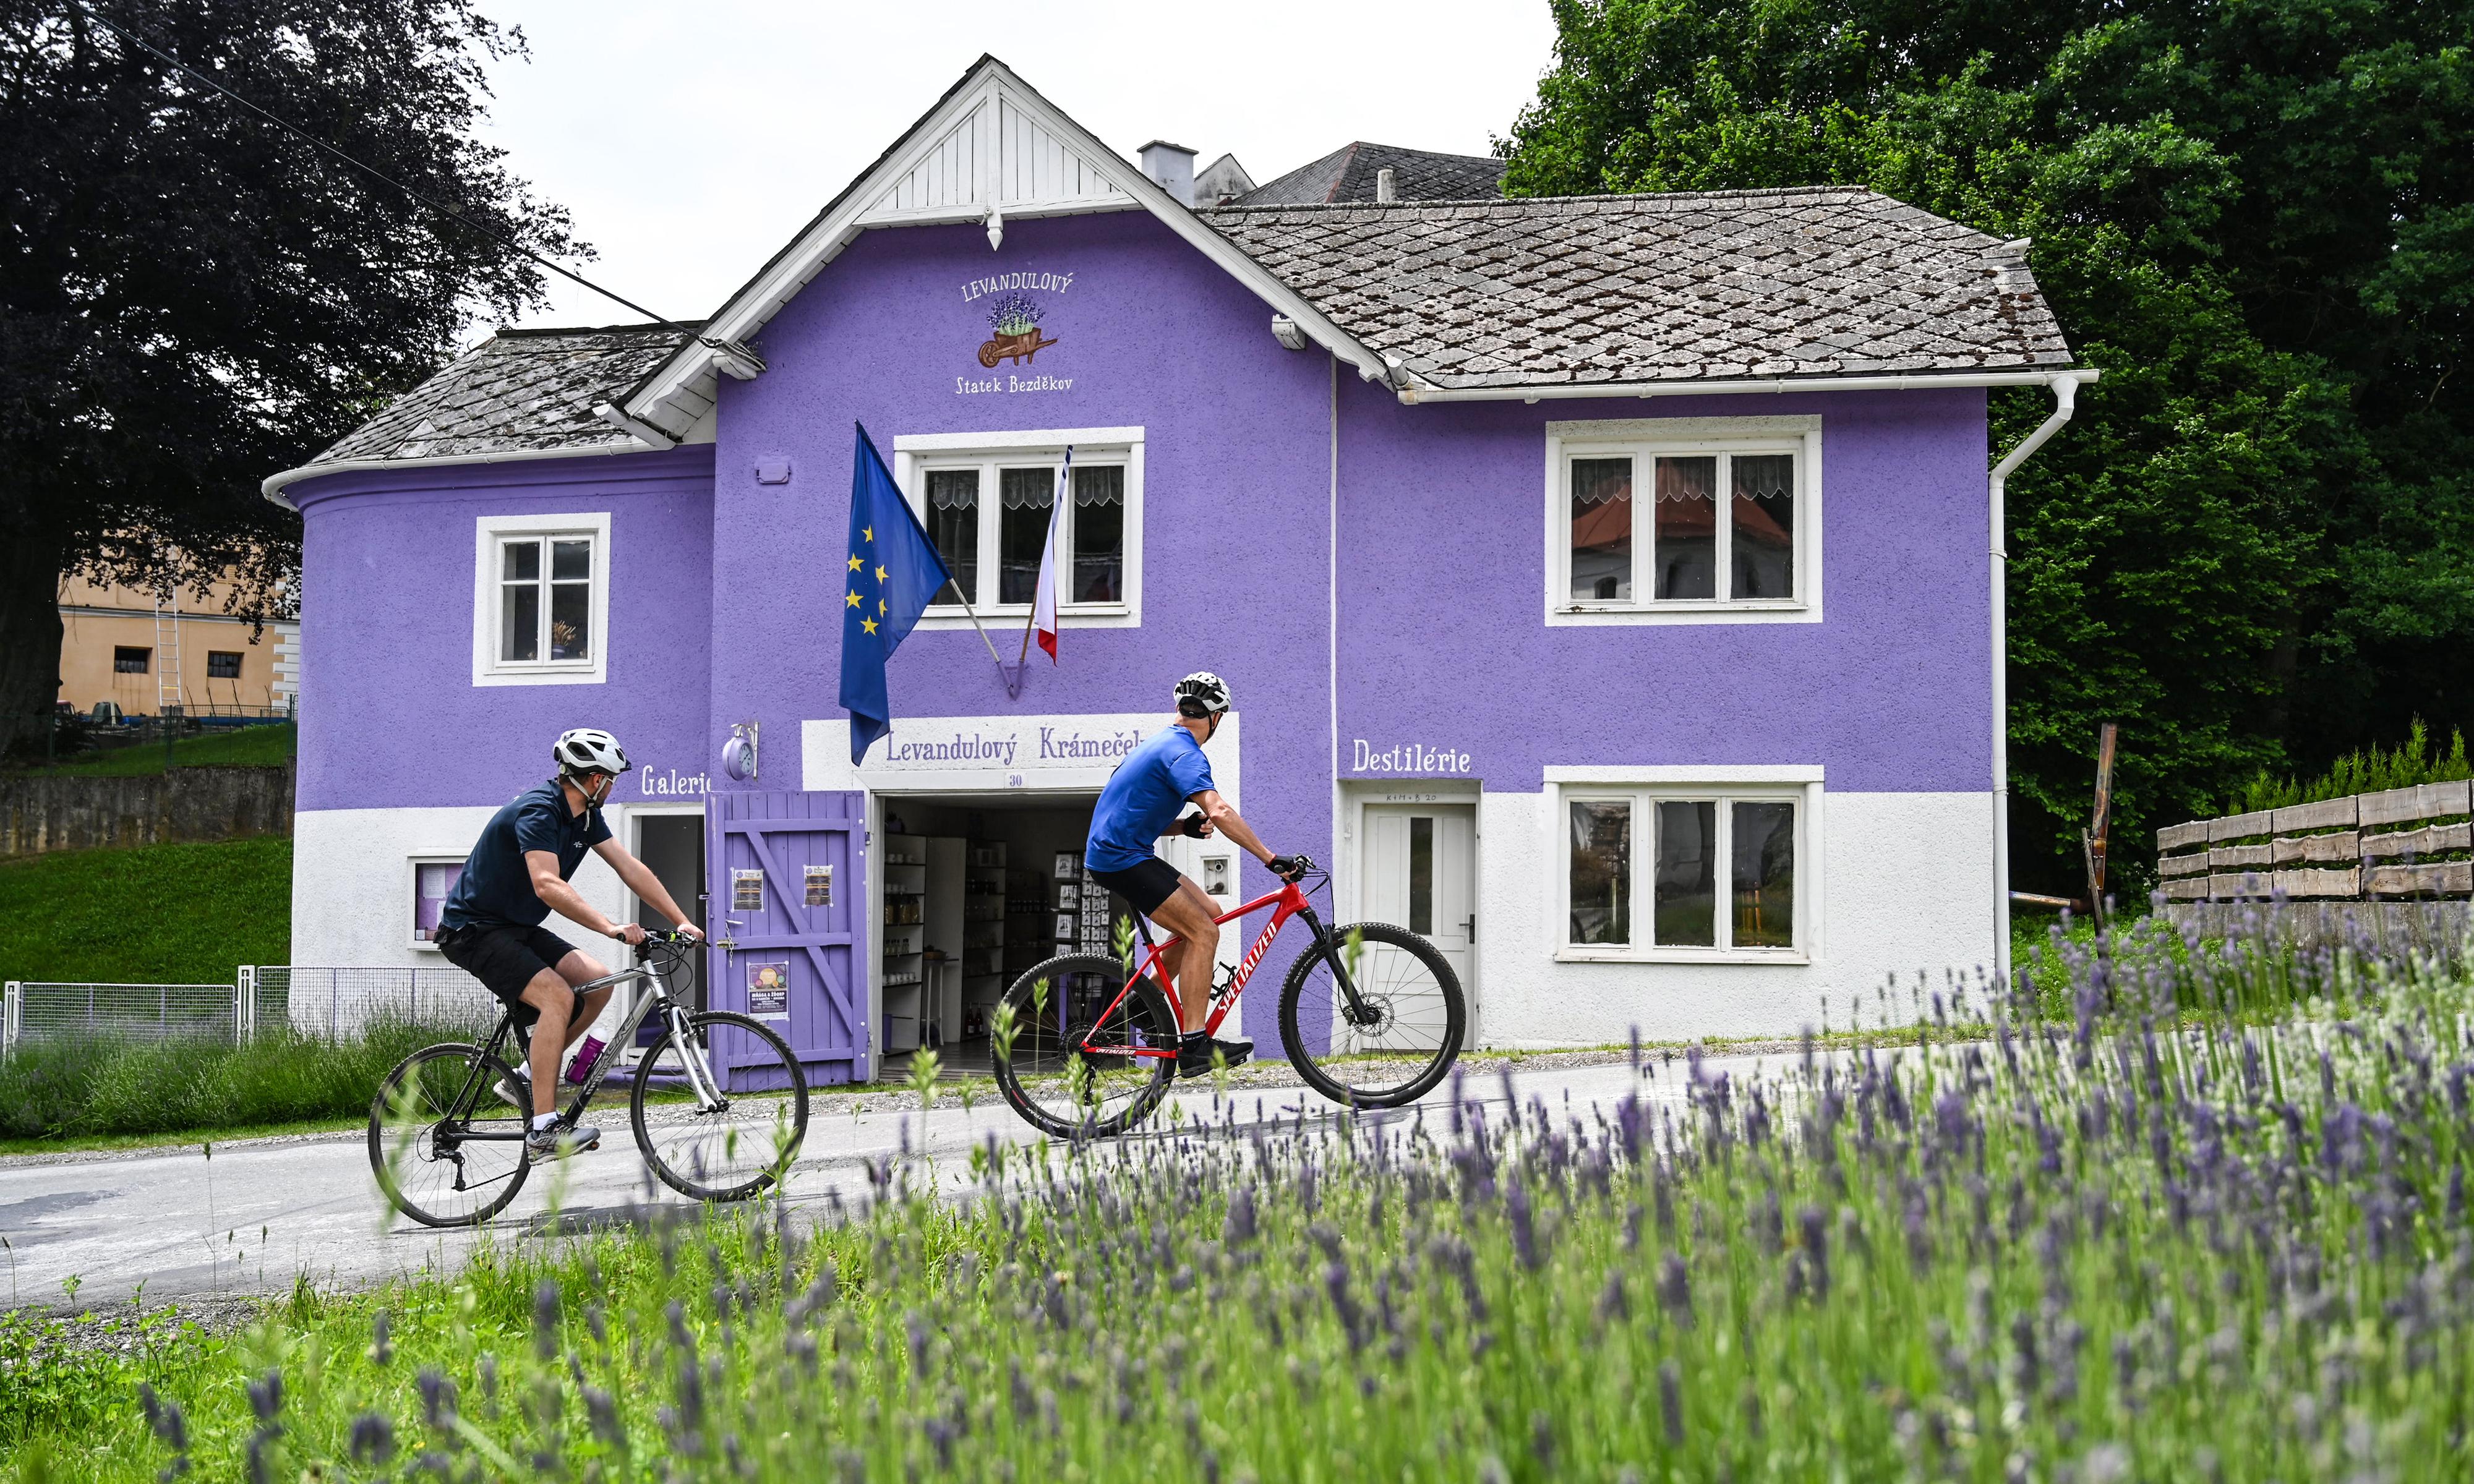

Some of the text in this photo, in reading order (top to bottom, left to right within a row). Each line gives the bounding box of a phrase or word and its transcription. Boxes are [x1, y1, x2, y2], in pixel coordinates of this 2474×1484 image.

[961, 272, 1074, 302] LEVANDULOVÝ
[956, 375, 1073, 394] Statek Bezděkov
[886, 730, 1017, 765] Levandulový
[1353, 739, 1471, 772] Destilérie
[1009, 774, 1022, 787] 30
[1218, 921, 1277, 1017] SPECIALIZED
